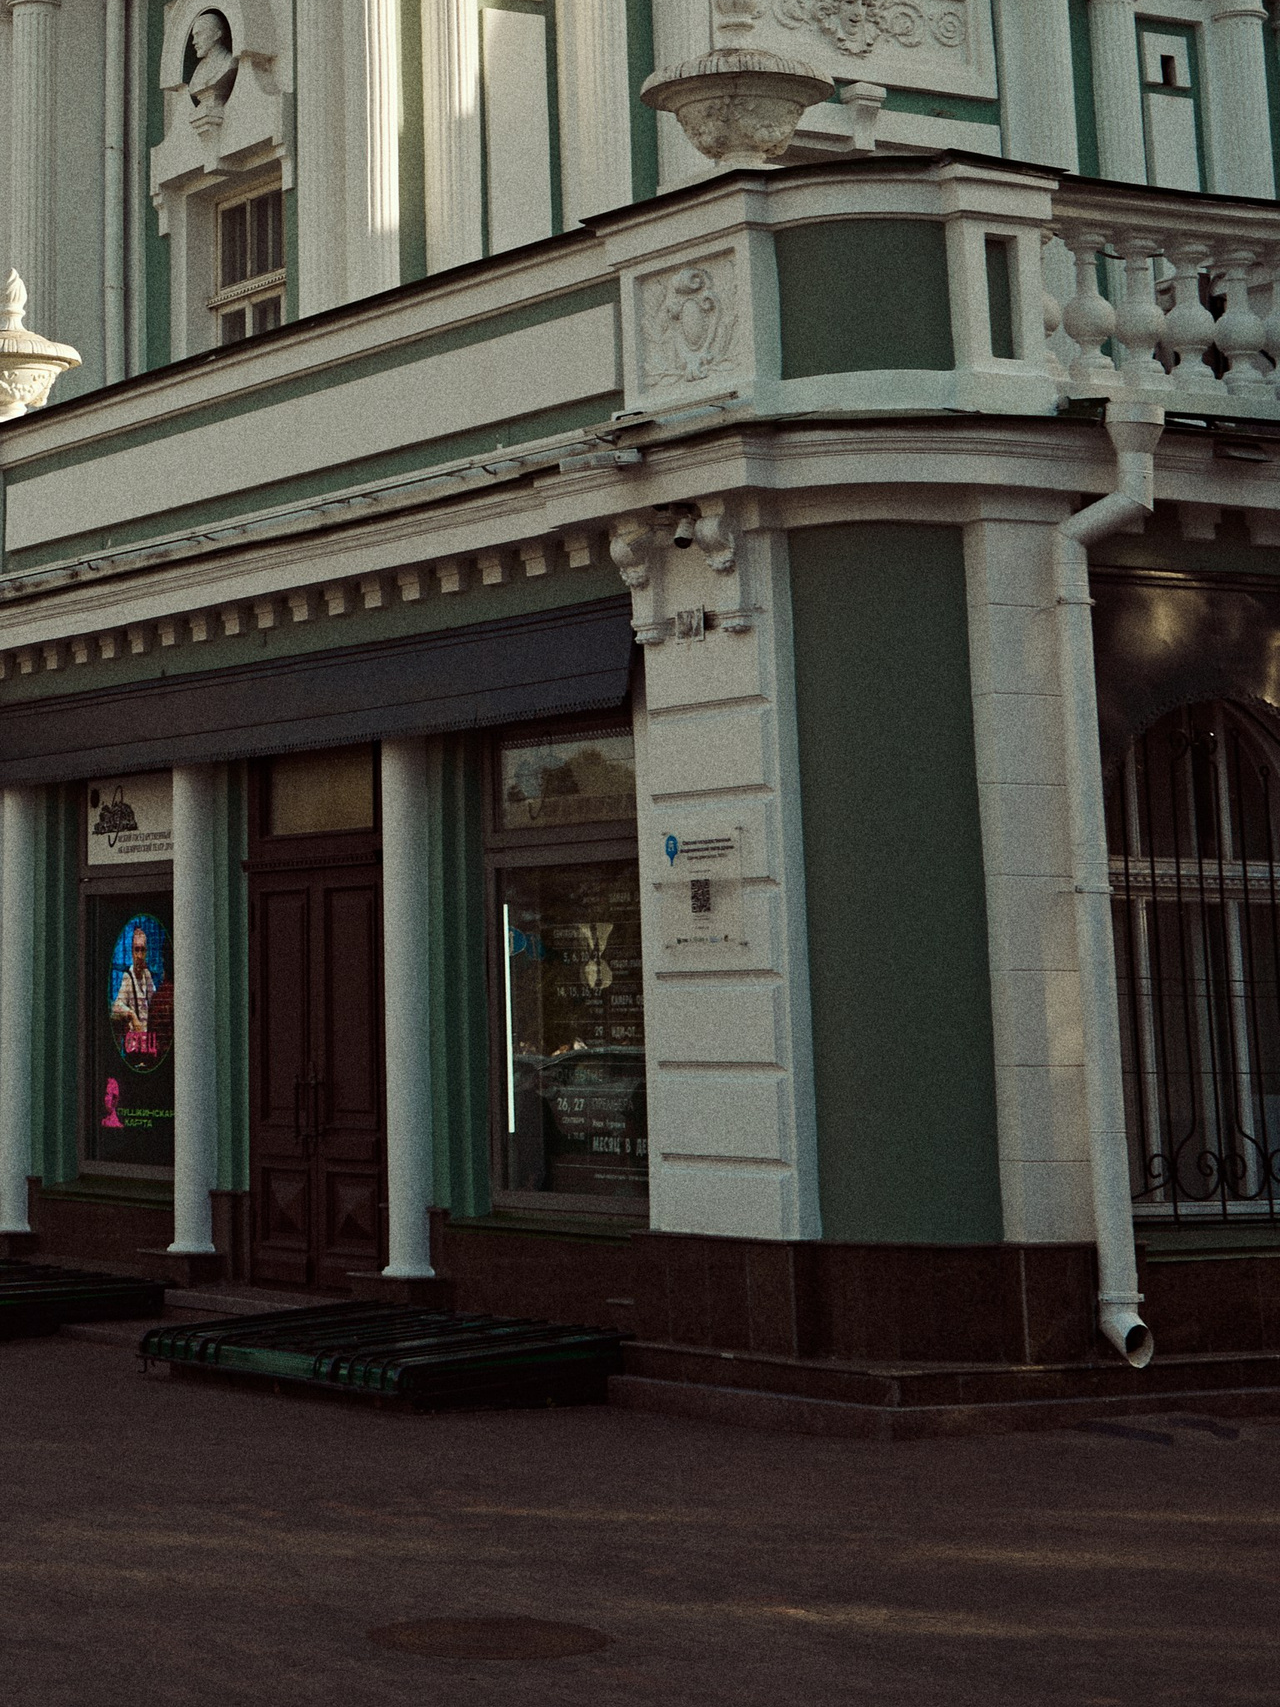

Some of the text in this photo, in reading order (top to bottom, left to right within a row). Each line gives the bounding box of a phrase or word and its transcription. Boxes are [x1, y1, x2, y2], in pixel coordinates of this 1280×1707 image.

[125, 1032, 157, 1057] ОТЕЦ
[556, 1096, 586, 1114] 26, 27
[591, 1135, 621, 1156] МЕСЯЦ
[624, 1137, 633, 1154] В
